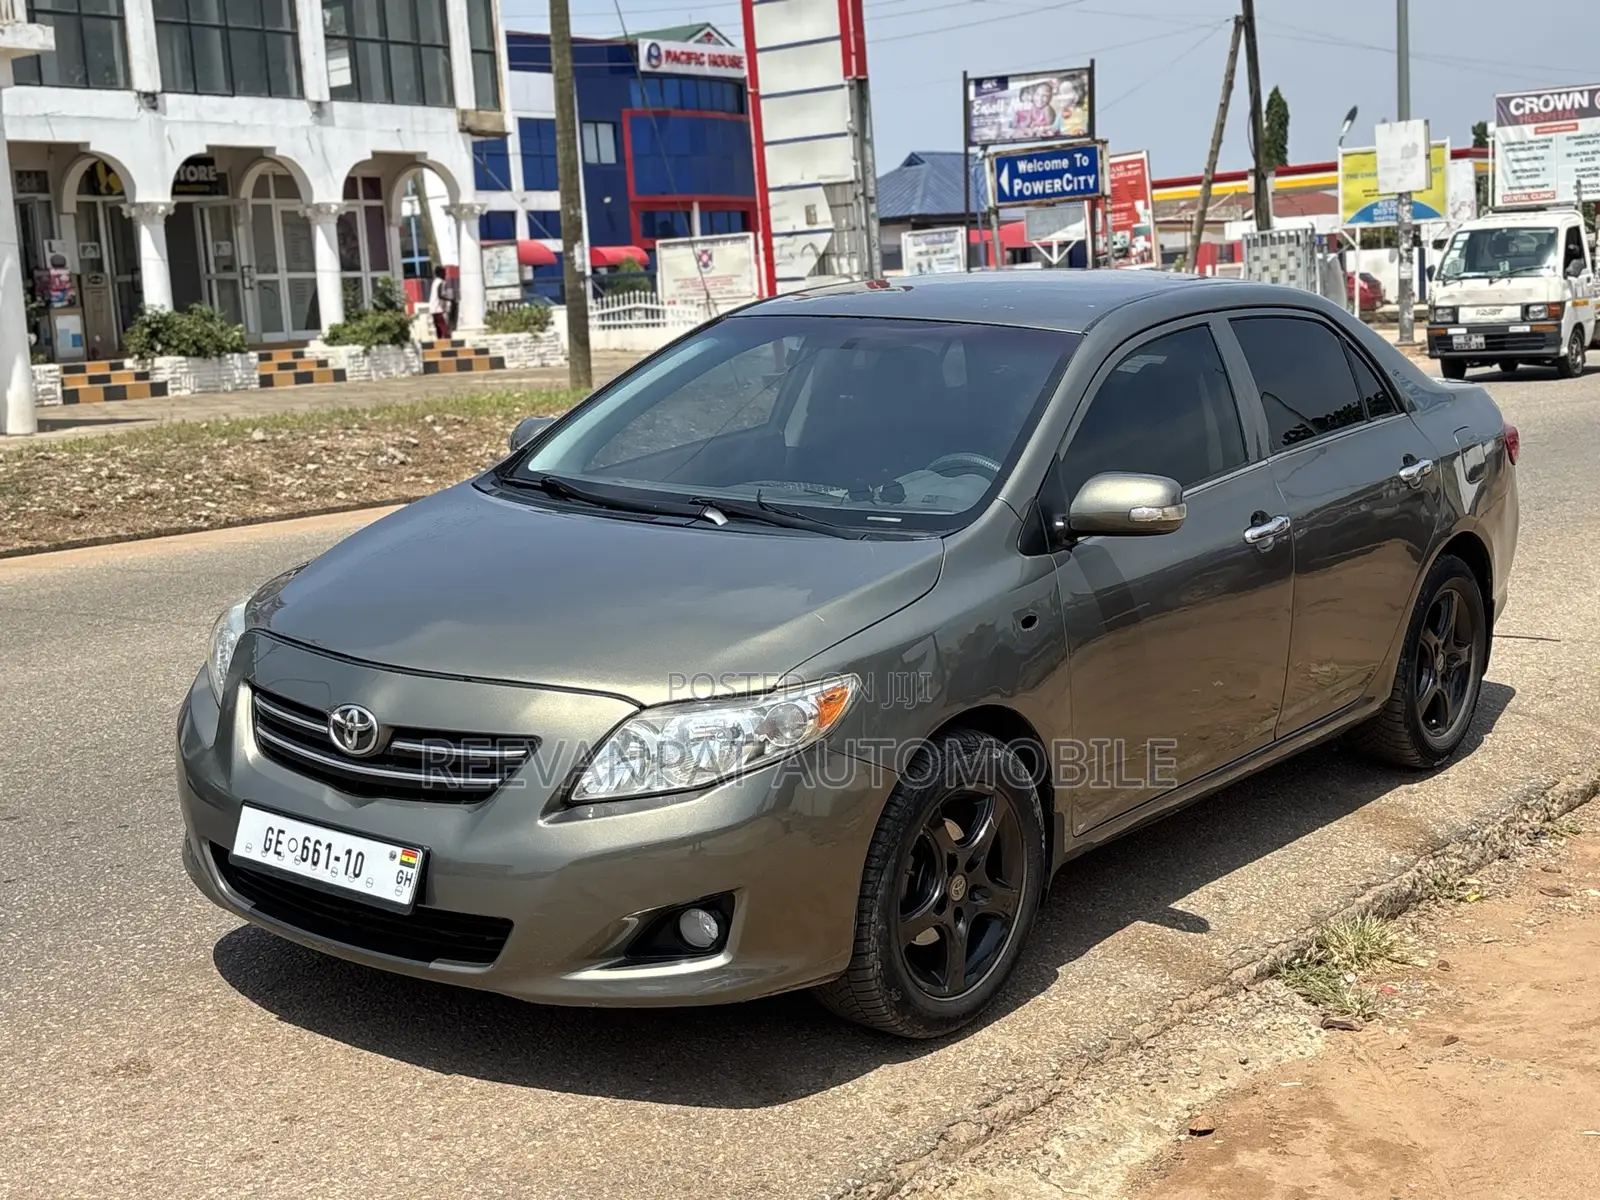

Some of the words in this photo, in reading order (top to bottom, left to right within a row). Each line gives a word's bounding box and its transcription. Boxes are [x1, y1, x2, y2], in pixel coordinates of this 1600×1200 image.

[664, 50, 704, 66] PACIFIC
[708, 54, 744, 69] HOUSE
[1509, 90, 1589, 116] CROWN
[1518, 108, 1578, 124] HOSPITAL
[1017, 158, 1069, 174] Welcome
[1073, 153, 1090, 168] To
[263, 826, 286, 856] GE
[301, 836, 365, 878] 661-10
[396, 869, 414, 888] GH
